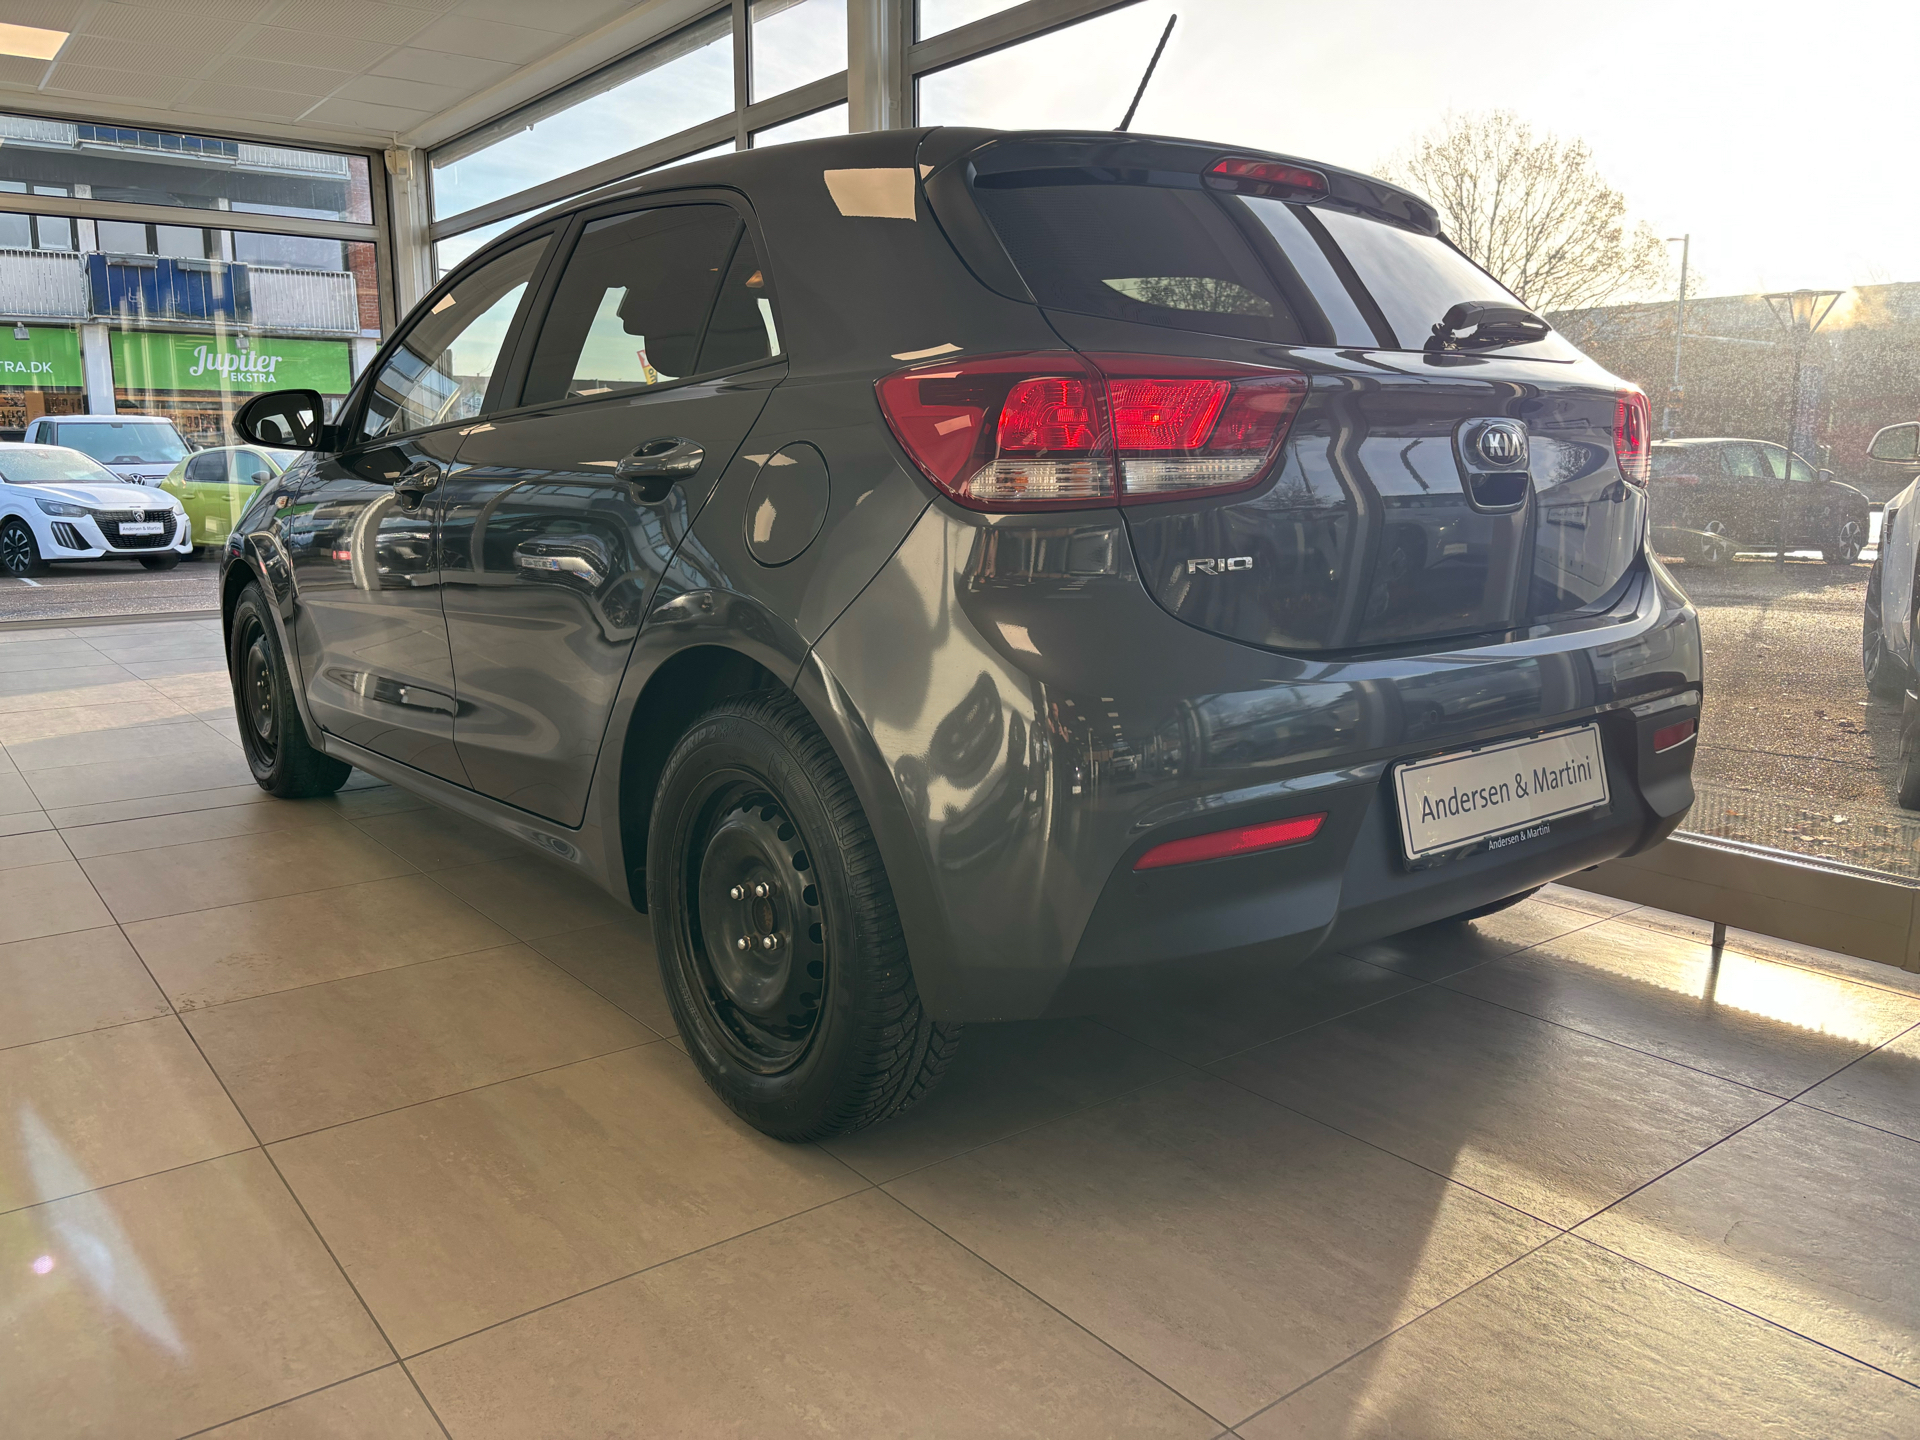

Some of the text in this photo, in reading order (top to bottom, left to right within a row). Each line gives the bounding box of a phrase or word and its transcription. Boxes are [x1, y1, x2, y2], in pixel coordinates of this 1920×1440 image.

[189, 345, 283, 378] Jupiter
[230, 372, 276, 383] EKSTRA
[1487, 433, 1521, 457] KIA
[1187, 556, 1253, 575] RIO
[1420, 755, 1592, 824] Andersen & Martini
[1488, 823, 1551, 851] Andersen & Martini
